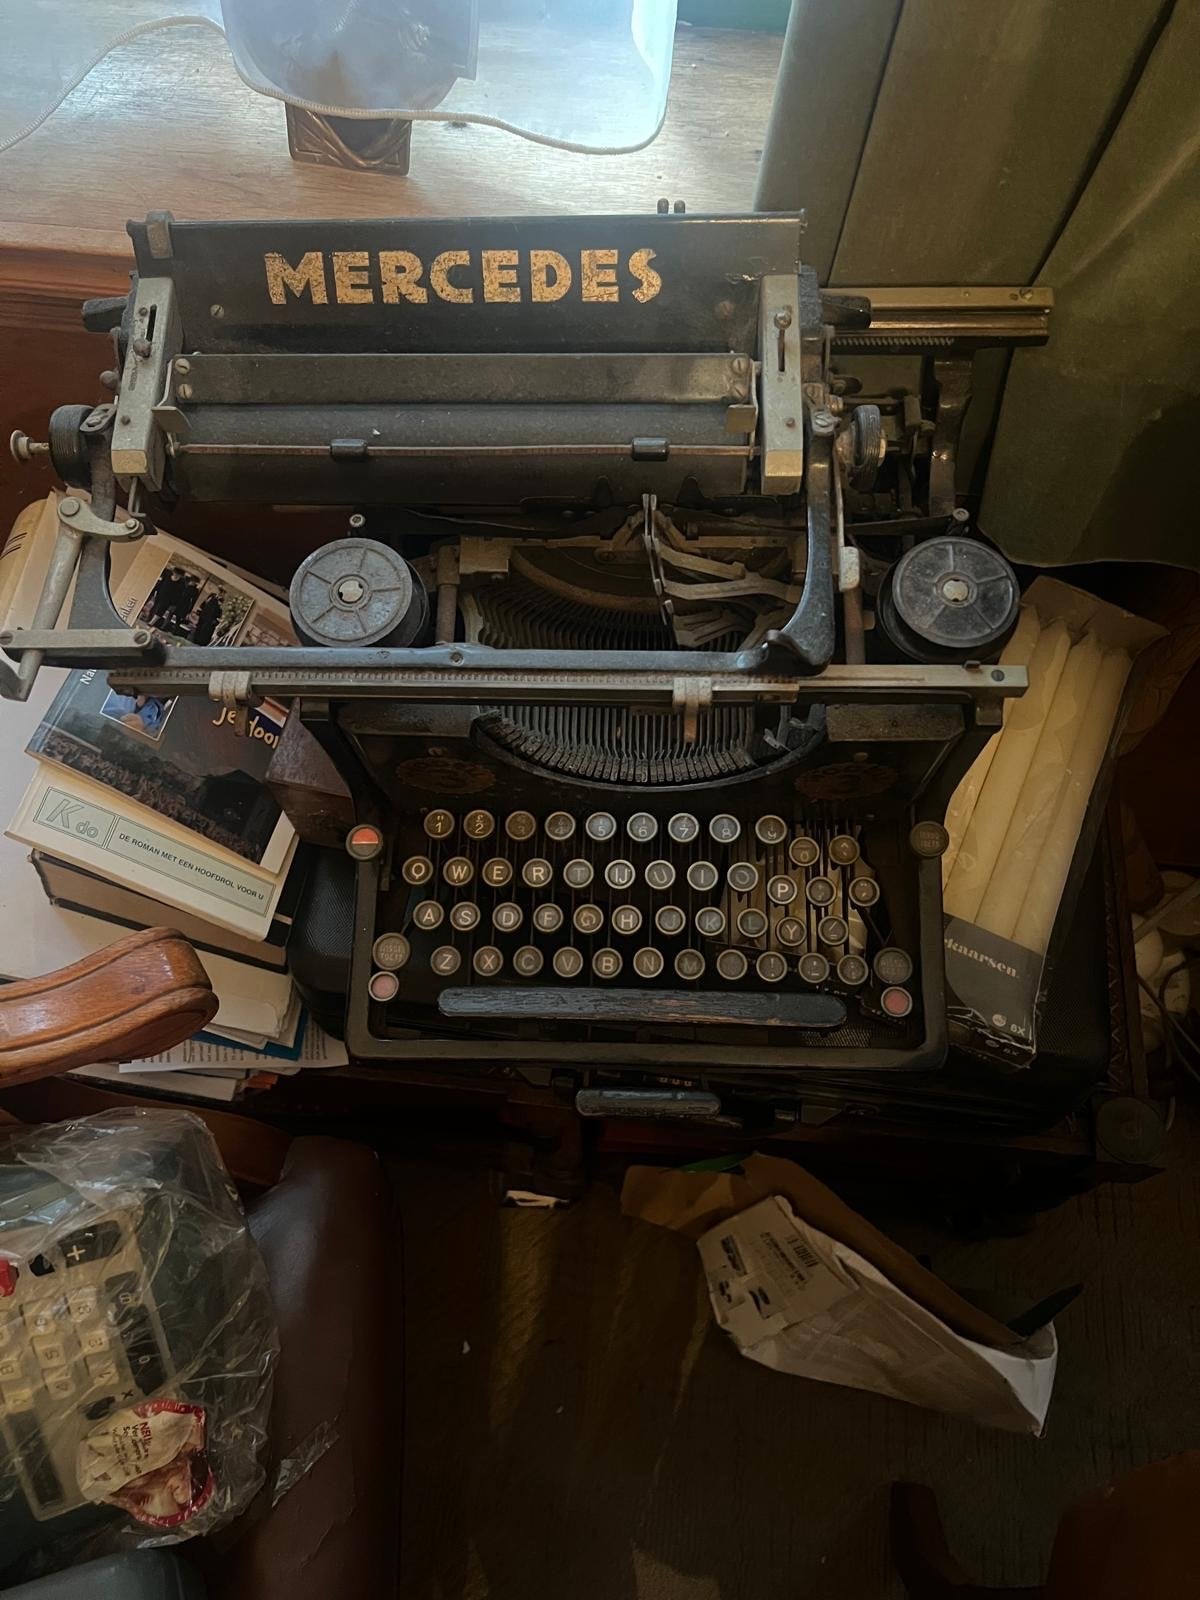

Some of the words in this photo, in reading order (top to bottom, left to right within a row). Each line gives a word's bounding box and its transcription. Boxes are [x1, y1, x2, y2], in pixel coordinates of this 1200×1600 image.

[264, 248, 663, 304] MERCEDES
[46, 798, 84, 829] K
[75, 821, 99, 839] do
[475, 822, 484, 834] 2
[598, 825, 606, 837] 5
[638, 826, 648, 838] 6
[679, 827, 689, 838] 7
[721, 827, 732, 839] 8
[119, 833, 130, 842] DE
[131, 838, 161, 857] ROMAN
[160, 850, 178, 863] MET
[178, 858, 194, 871] EEN
[194, 865, 236, 889] HOOFDROL
[237, 883, 259, 897] VOOR
[258, 893, 265, 901] U
[411, 862, 425, 880] Q
[452, 865, 468, 880] W
[493, 866, 505, 880] E
[532, 866, 545, 881] R
[573, 867, 586, 881] T
[653, 869, 668, 884] U
[777, 883, 789, 898] P
[422, 908, 436, 923] A
[459, 910, 472, 926] S
[502, 911, 514, 926] D
[543, 911, 553, 926] F
[621, 914, 633, 929] H
[665, 914, 677, 930] J
[705, 914, 718, 931] K
[748, 915, 758, 931] L
[785, 924, 798, 940] Y
[439, 953, 453, 969] Z
[482, 954, 495, 970] X
[521, 954, 536, 970] C
[561, 955, 574, 971] V
[601, 956, 614, 972] B
[643, 956, 655, 972] N
[683, 957, 697, 974] M
